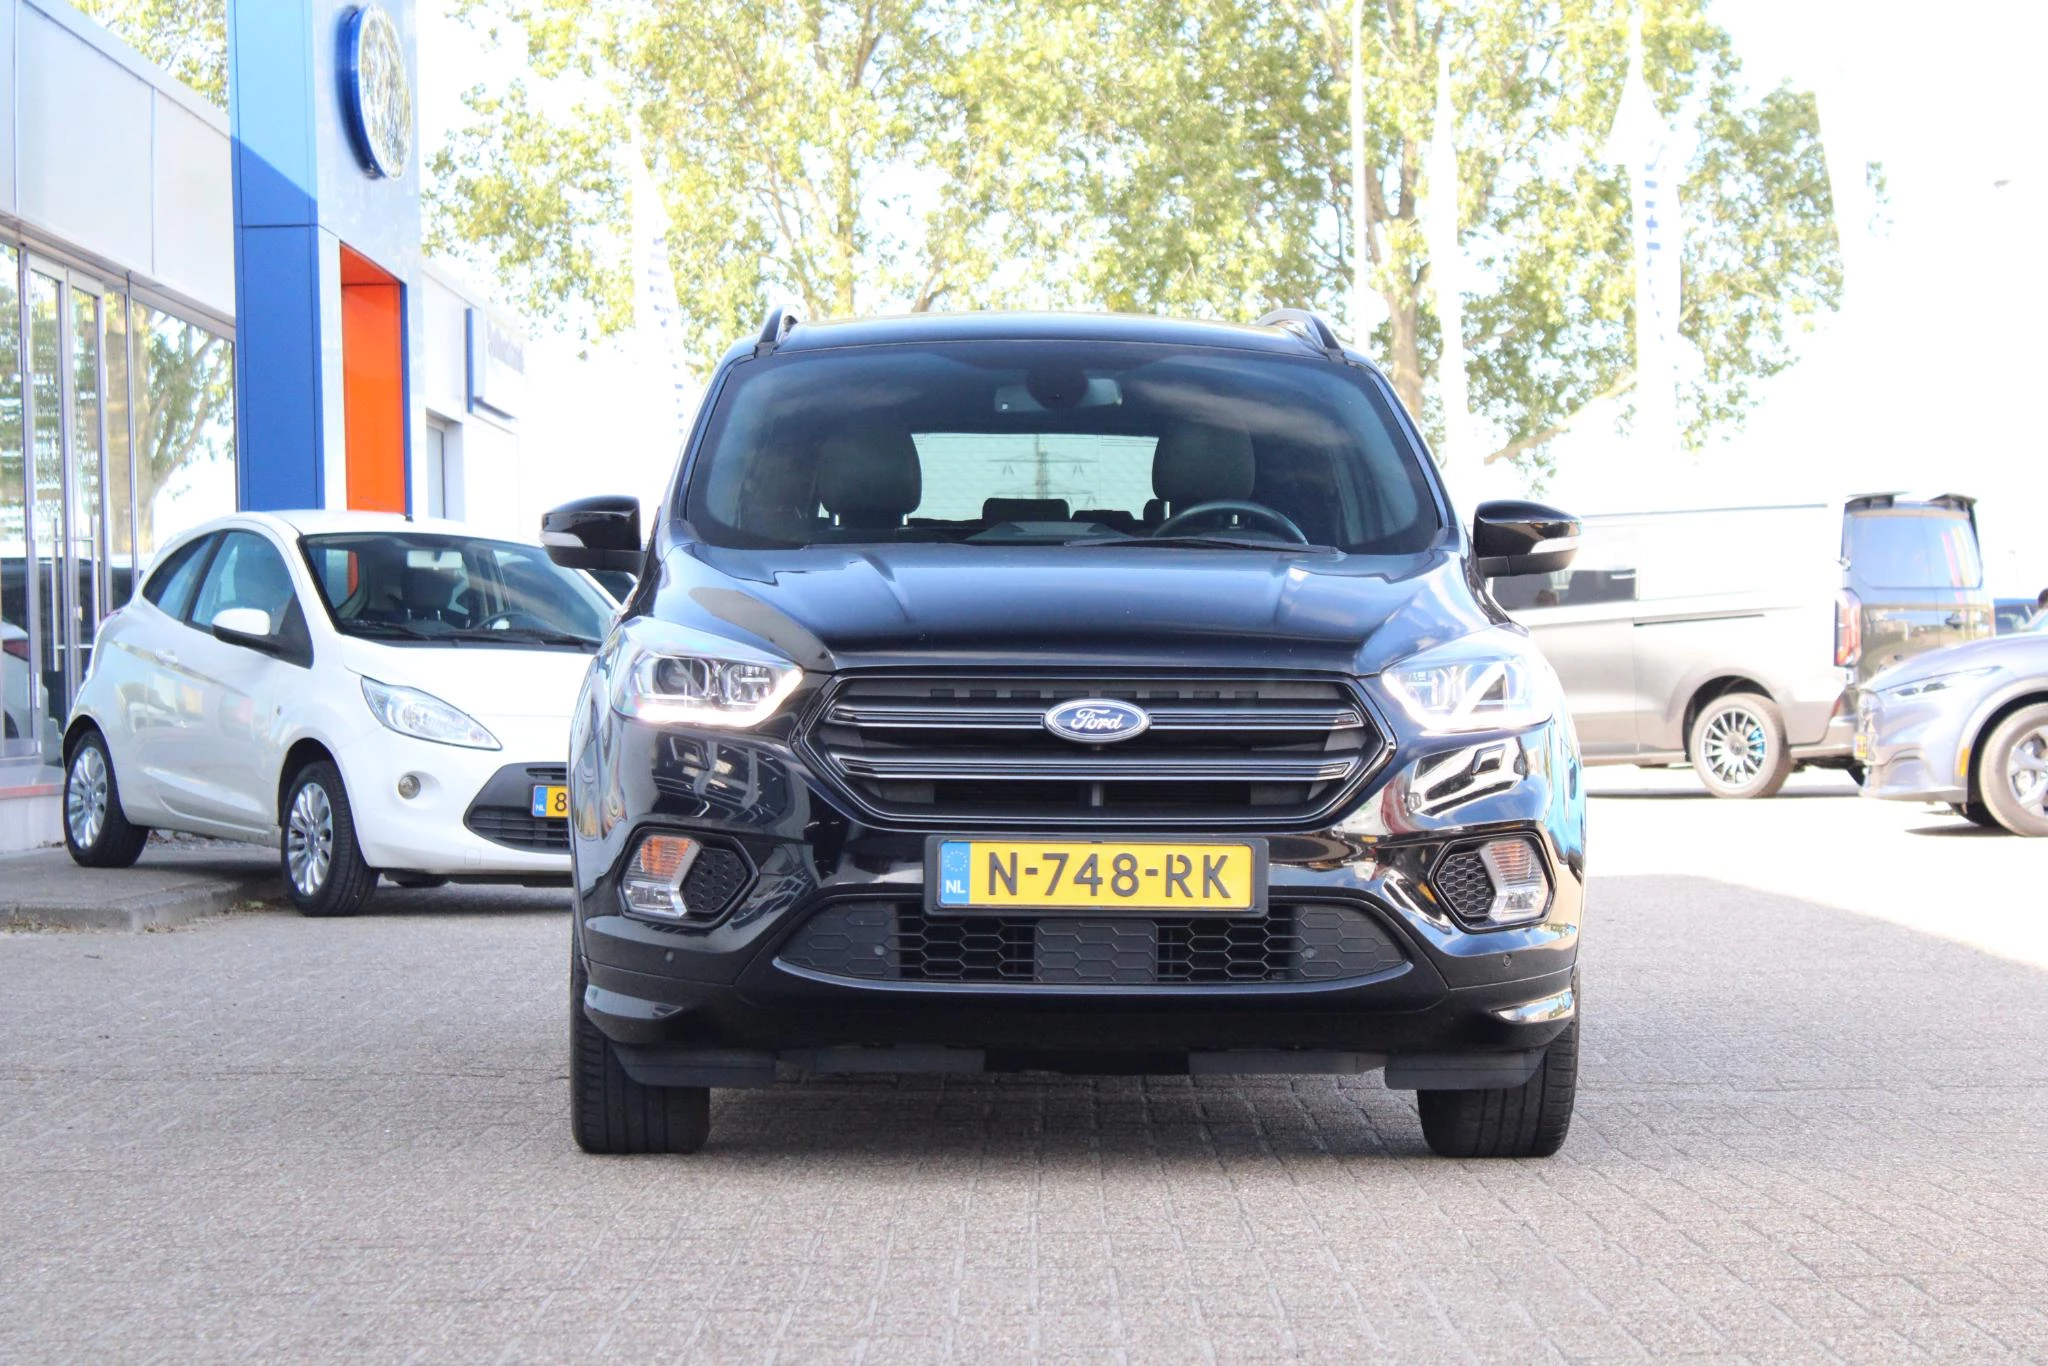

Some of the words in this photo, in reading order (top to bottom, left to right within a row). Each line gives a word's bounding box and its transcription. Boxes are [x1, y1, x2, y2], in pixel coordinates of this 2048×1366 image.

[1070, 703, 1124, 730] Ford
[945, 880, 966, 894] NL
[988, 852, 1232, 899] N-748-RK
